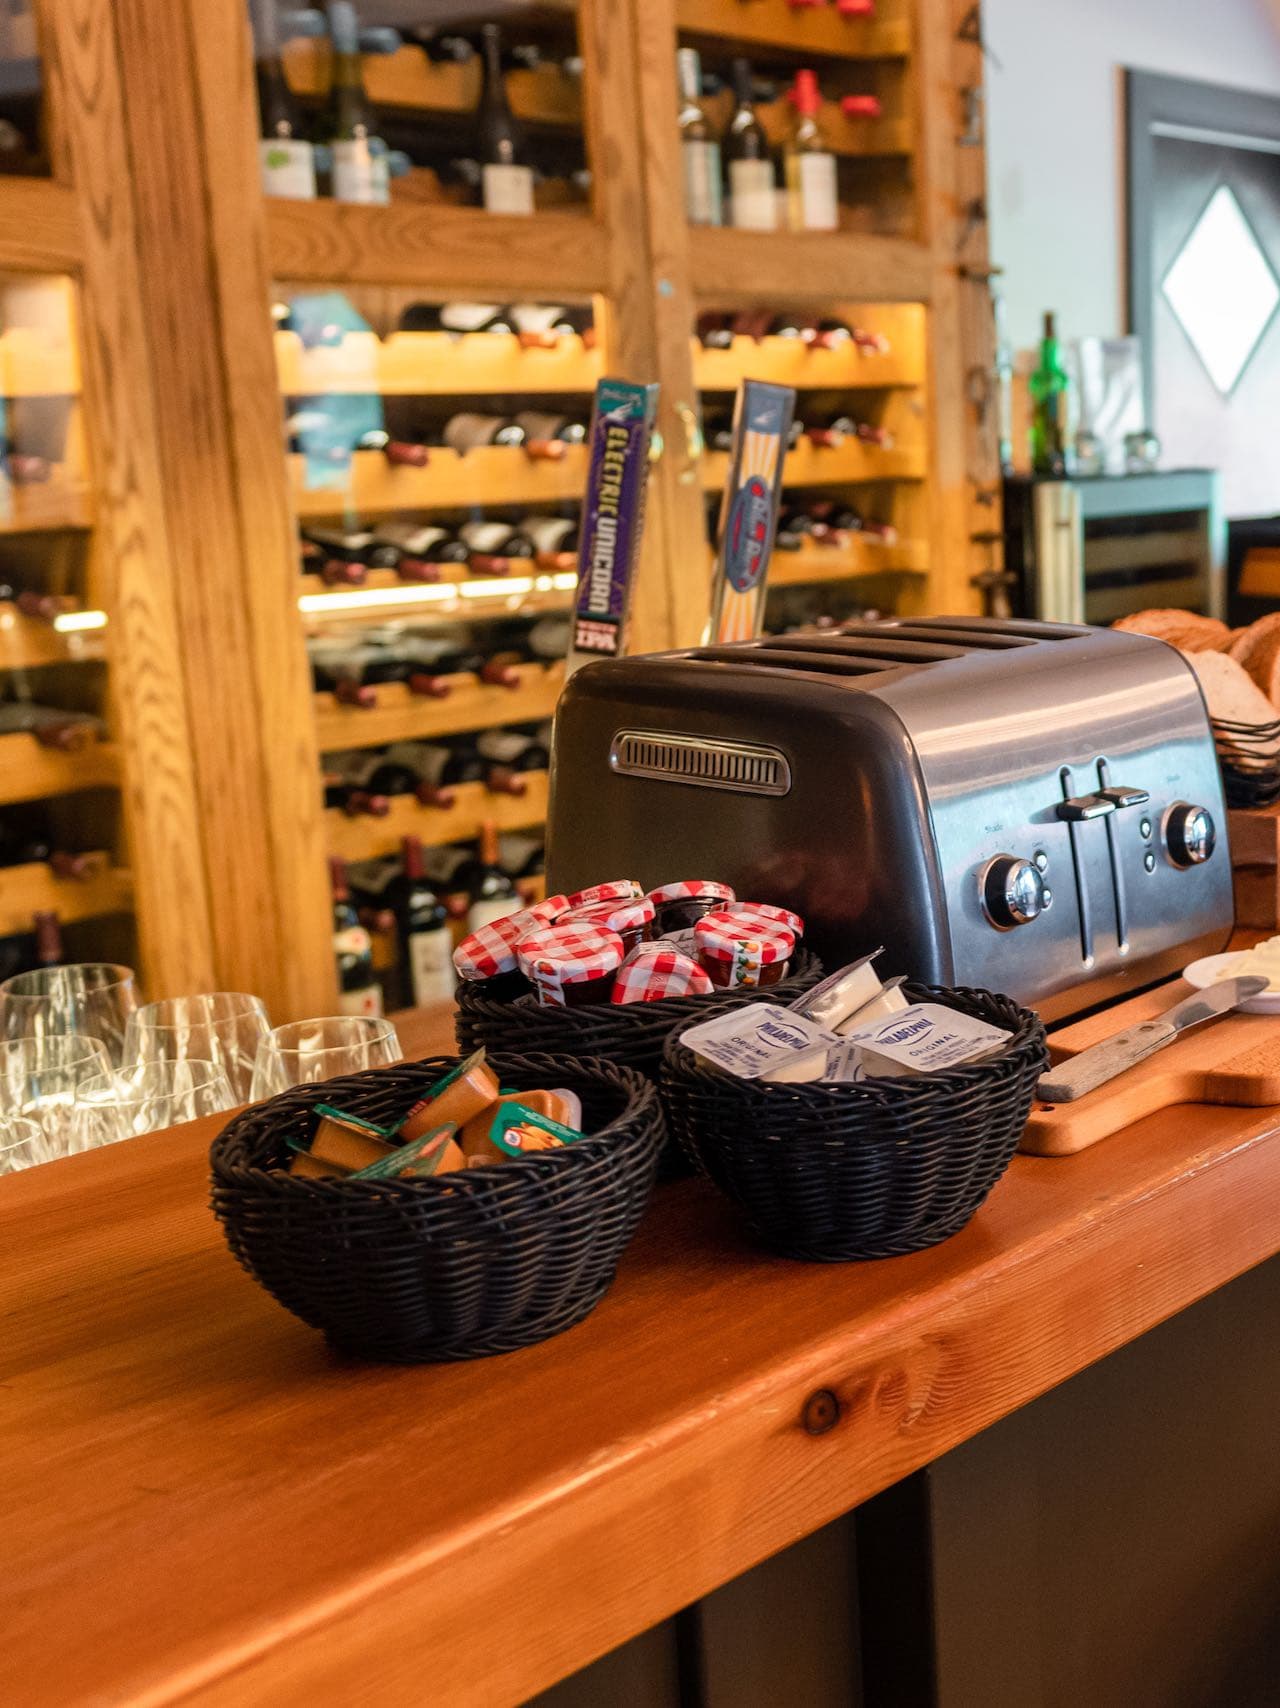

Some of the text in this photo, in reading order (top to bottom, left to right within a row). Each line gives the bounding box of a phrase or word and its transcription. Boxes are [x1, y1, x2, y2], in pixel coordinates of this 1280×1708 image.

[597, 426, 630, 516] ELECTRIC
[575, 630, 617, 651] IPA
[755, 1021, 811, 1051] PHILADELPHIA
[874, 1018, 937, 1045] PHILADELPHIA
[731, 1037, 772, 1059] ORIGINAL
[909, 1033, 958, 1057] ORIGINAL
